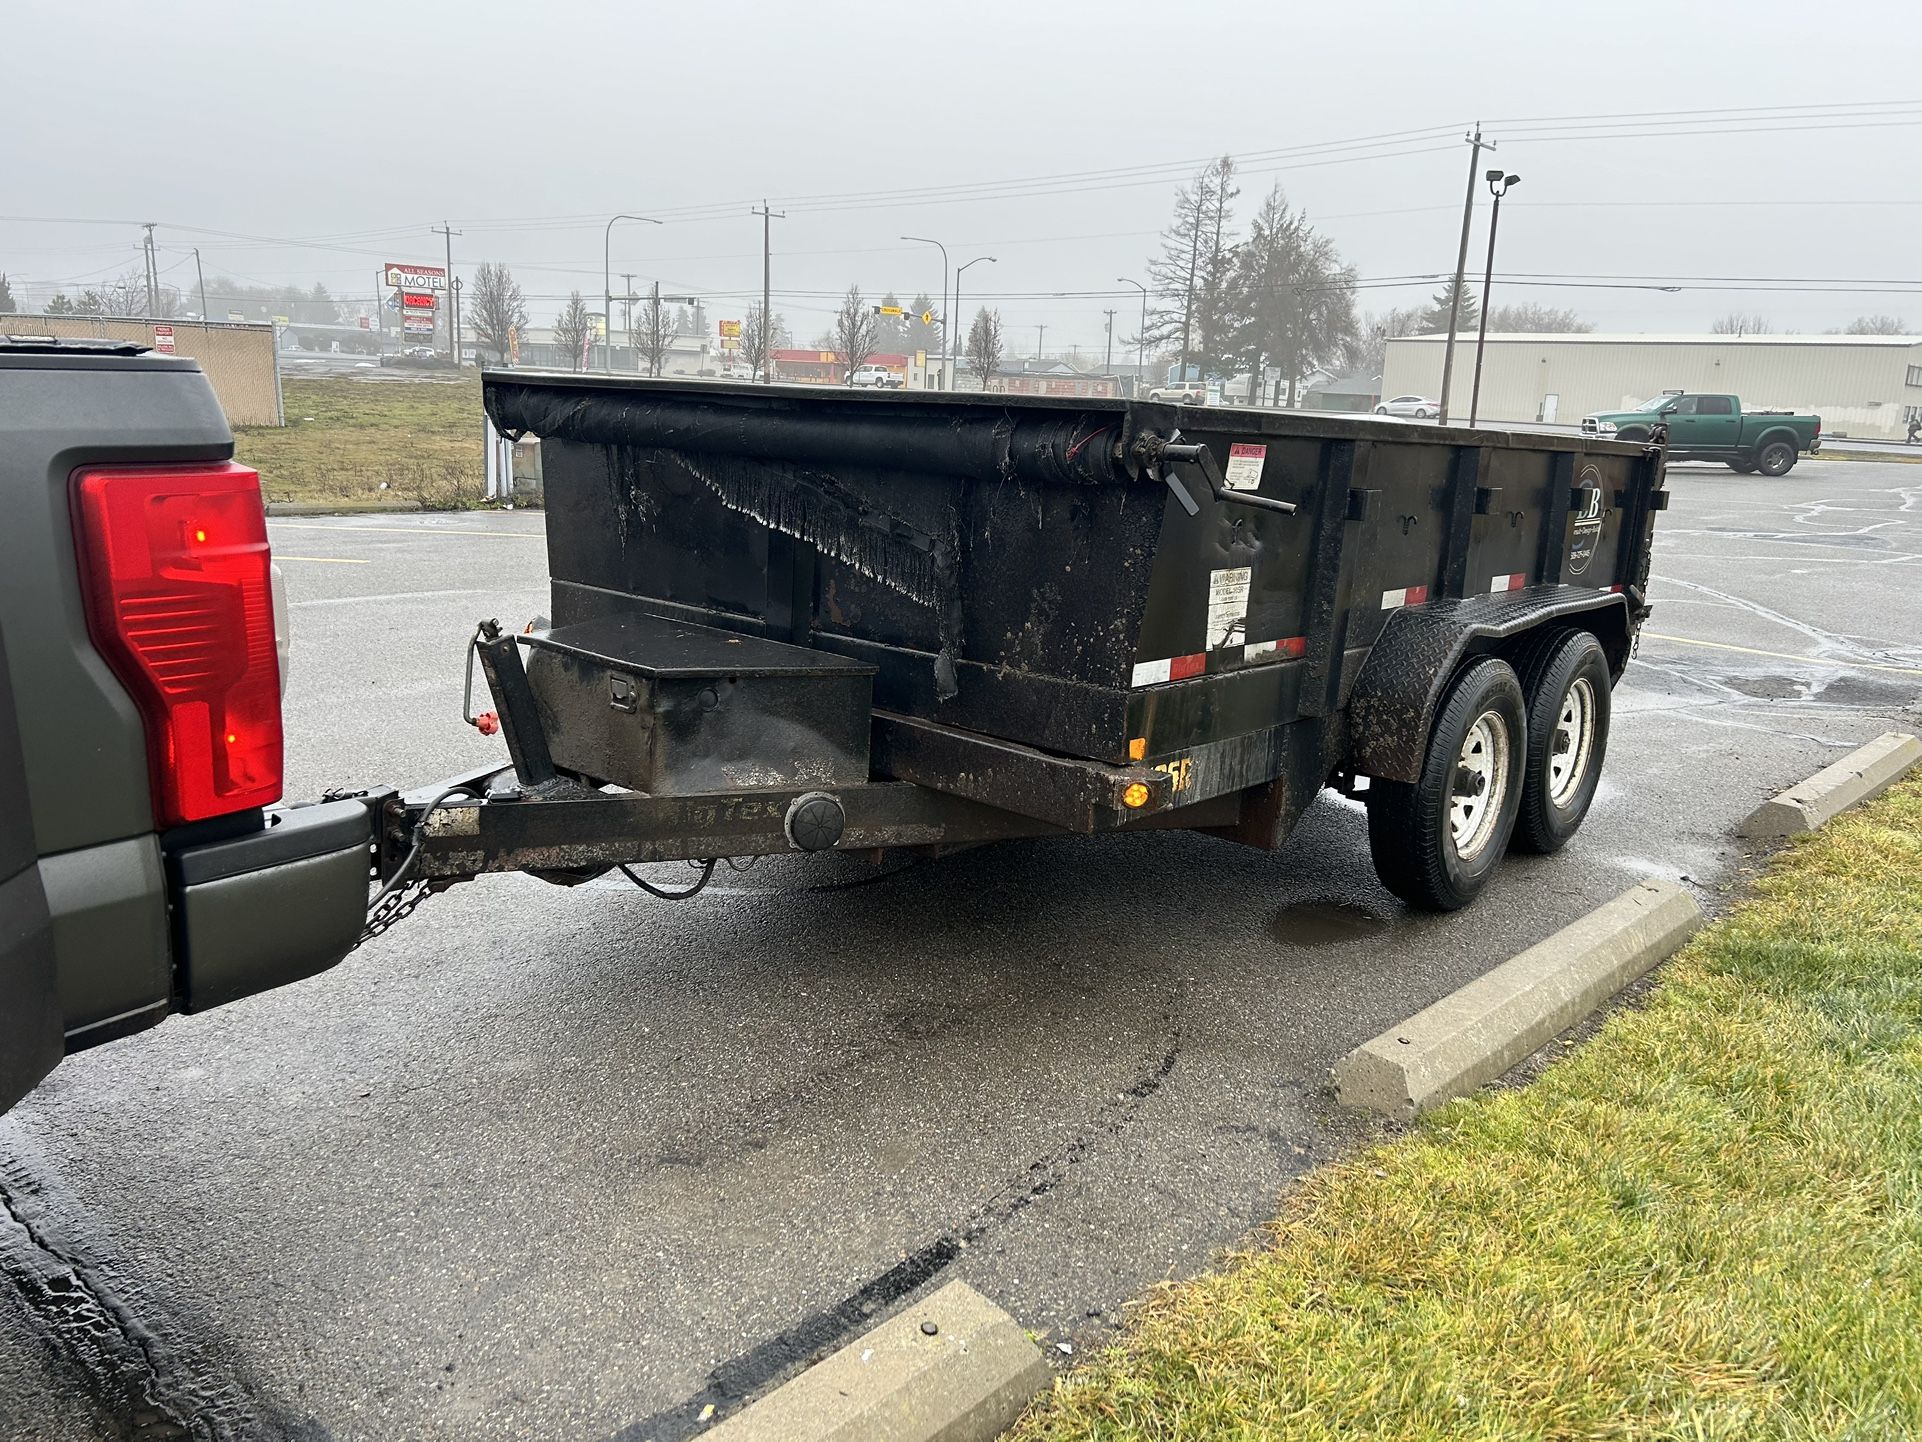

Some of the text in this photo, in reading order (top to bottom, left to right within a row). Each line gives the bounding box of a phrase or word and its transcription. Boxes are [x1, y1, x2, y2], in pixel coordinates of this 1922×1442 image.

[404, 276, 444, 288] MOTEL
[1241, 447, 1262, 455] DANGER
[1219, 571, 1249, 585] WARNING
